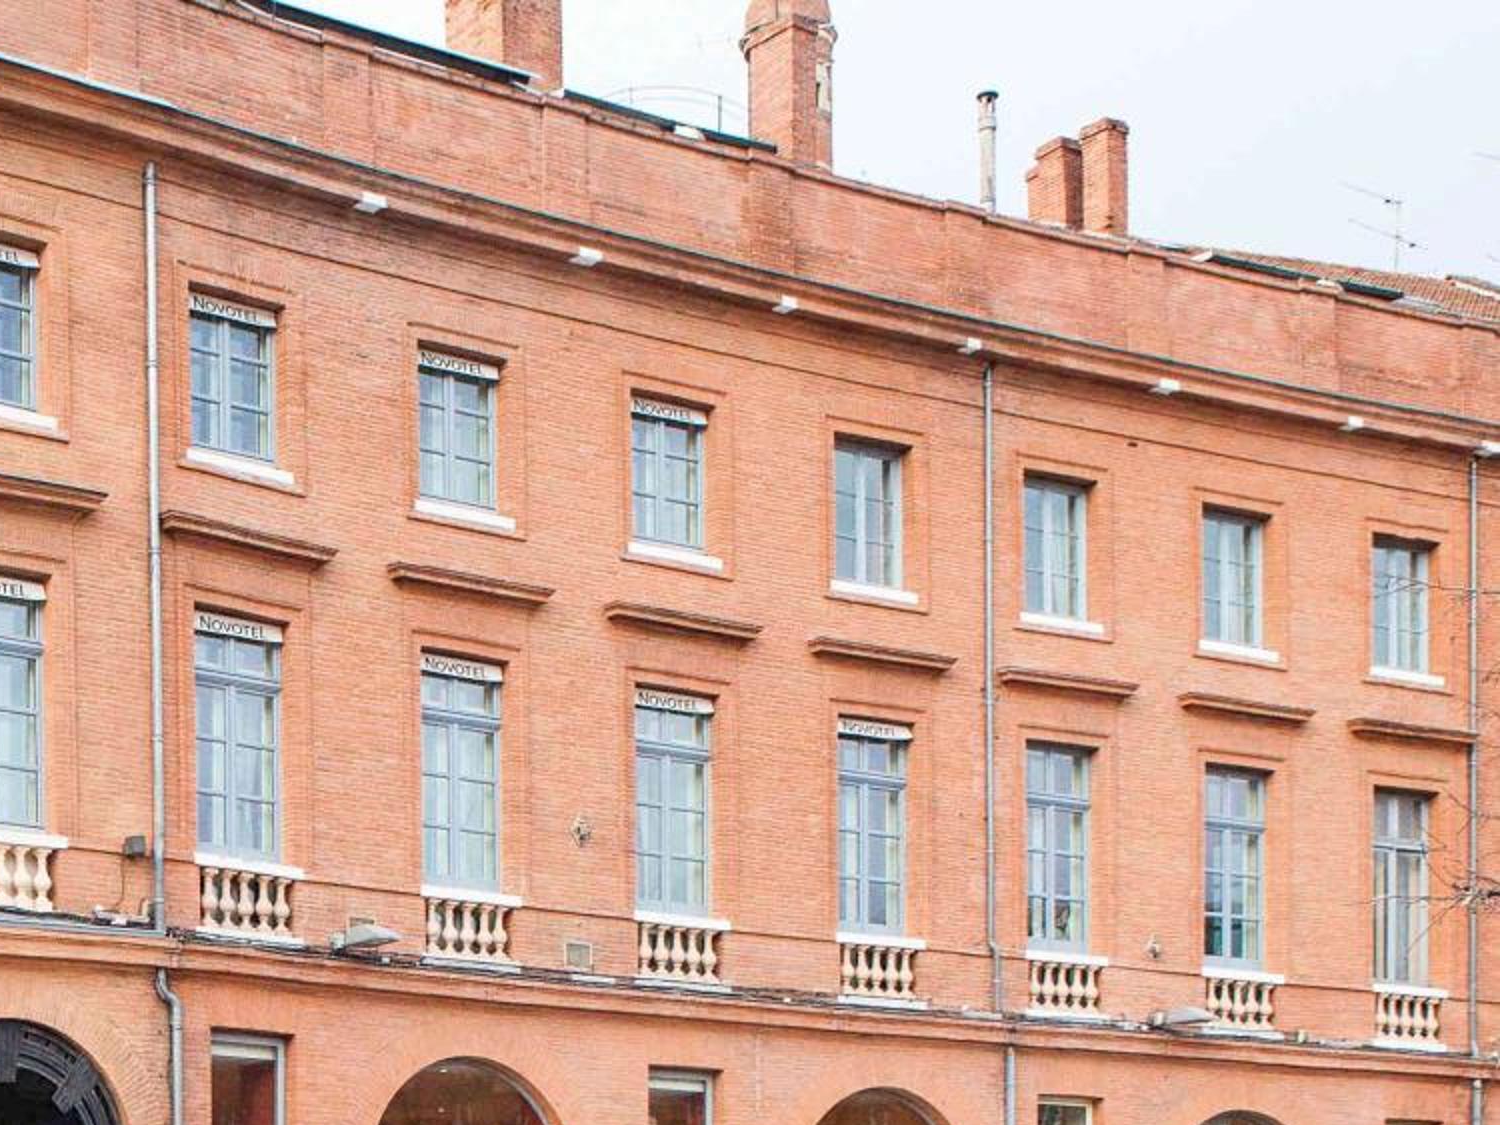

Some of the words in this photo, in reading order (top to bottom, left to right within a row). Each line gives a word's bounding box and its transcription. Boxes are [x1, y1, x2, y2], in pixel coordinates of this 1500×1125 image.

[193, 295, 262, 323] NOVOTEL
[421, 351, 485, 375] NOVOTEL
[199, 615, 267, 639] NOVOTEL
[425, 657, 486, 679] NOVOTEL
[638, 691, 699, 712] NOVOTEL
